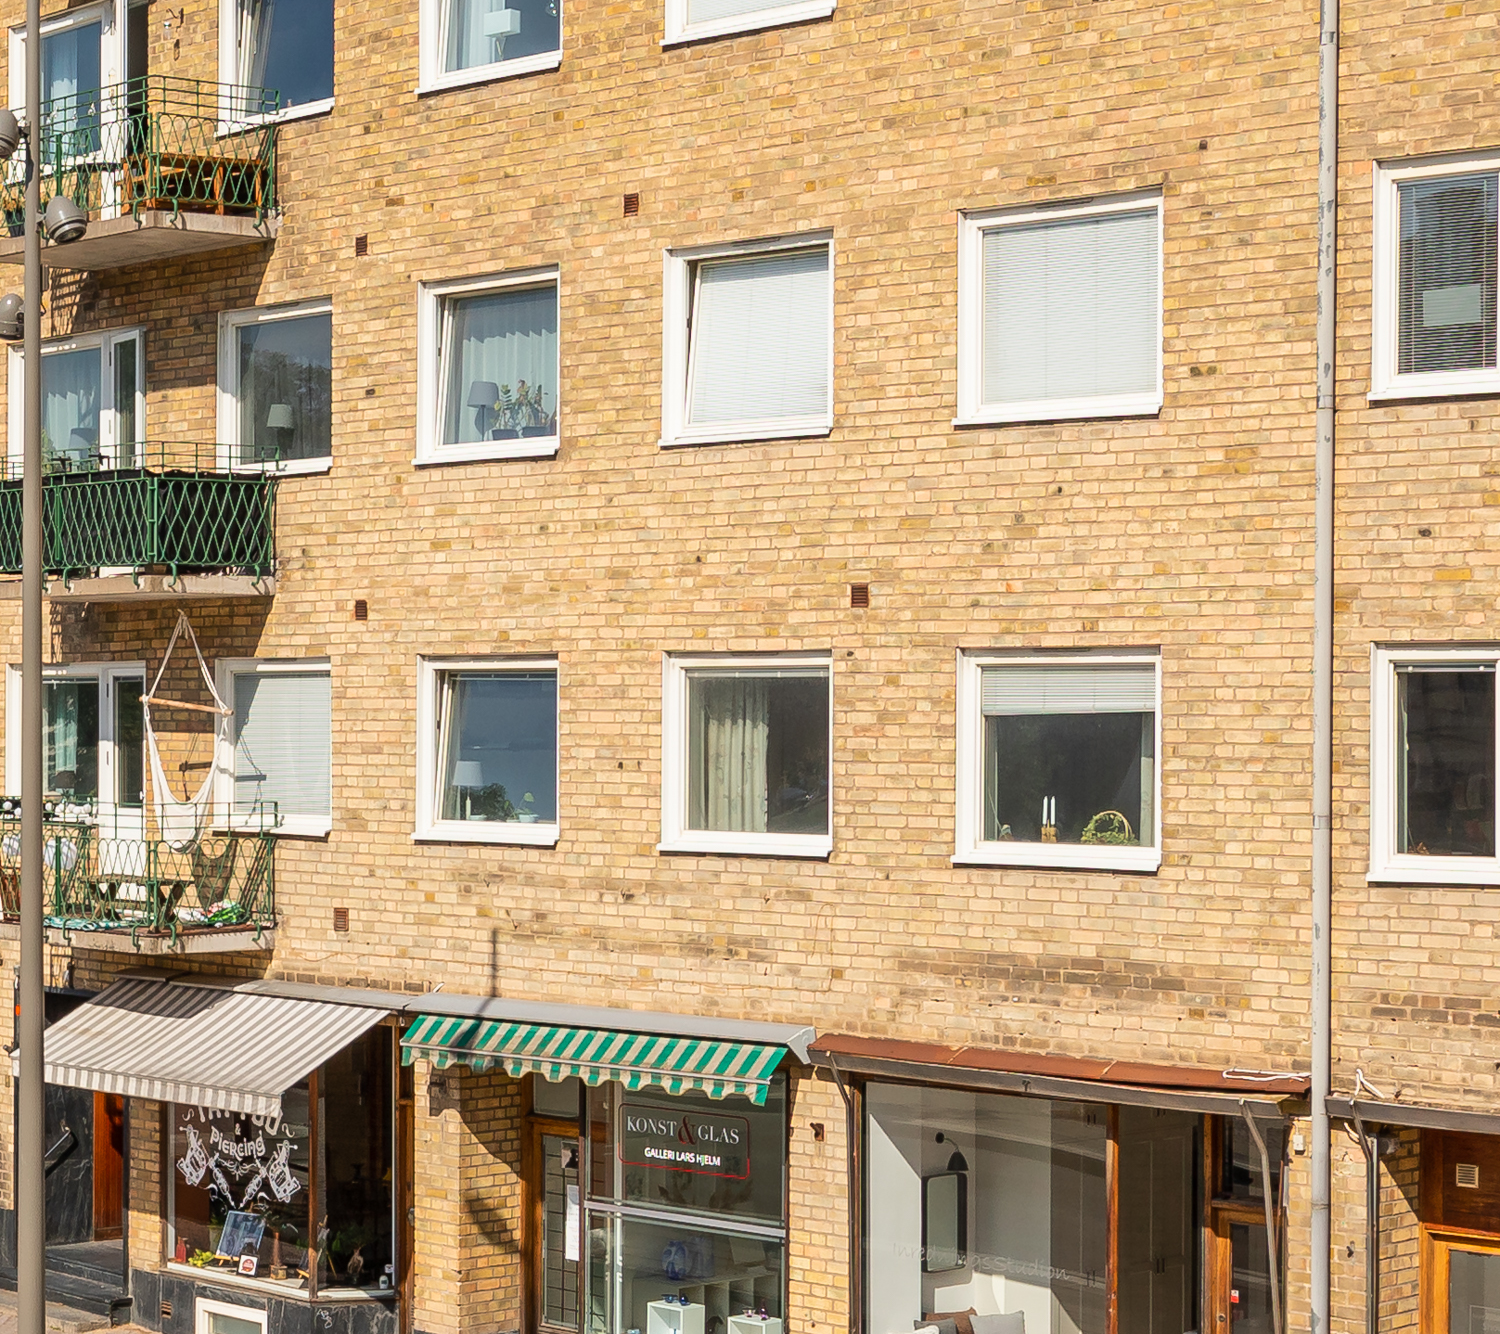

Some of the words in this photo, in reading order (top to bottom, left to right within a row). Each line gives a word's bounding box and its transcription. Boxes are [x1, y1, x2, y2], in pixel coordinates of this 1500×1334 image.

[626, 1115, 677, 1137] KONST
[677, 1115, 696, 1145] &
[697, 1124, 739, 1144] GLAS
[644, 1147, 675, 1161] GALLERI
[676, 1151, 695, 1163] LARS
[696, 1154, 721, 1167] HJELM
